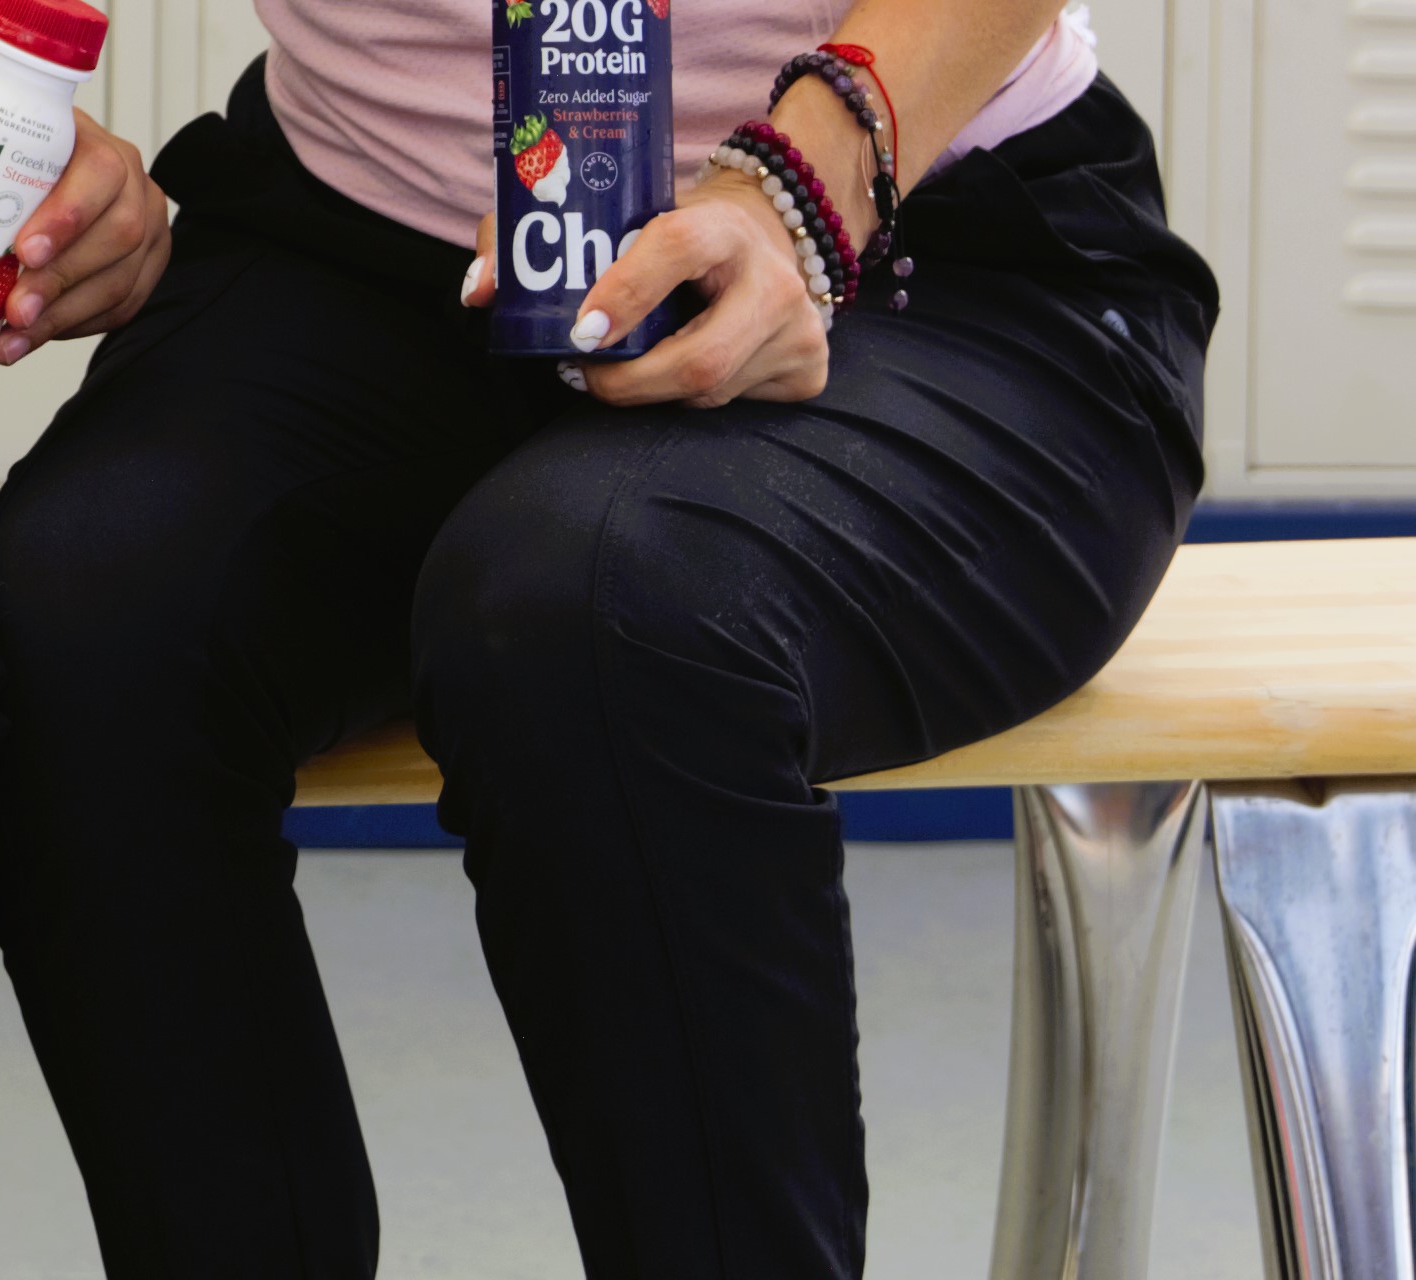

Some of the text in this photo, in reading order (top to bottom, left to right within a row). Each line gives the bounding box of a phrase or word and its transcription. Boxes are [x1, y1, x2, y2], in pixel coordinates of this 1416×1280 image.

[540, 45, 647, 75] Protein
[539, 90, 569, 104] Zero
[571, 89, 615, 103] Added
[552, 107, 639, 122] Strawberries
[20, 116, 55, 134] NATURAL
[568, 125, 627, 139] & Cream
[11, 150, 45, 171] Greek
[584, 155, 615, 172] LACTOSE
[588, 177, 611, 188] FREE
